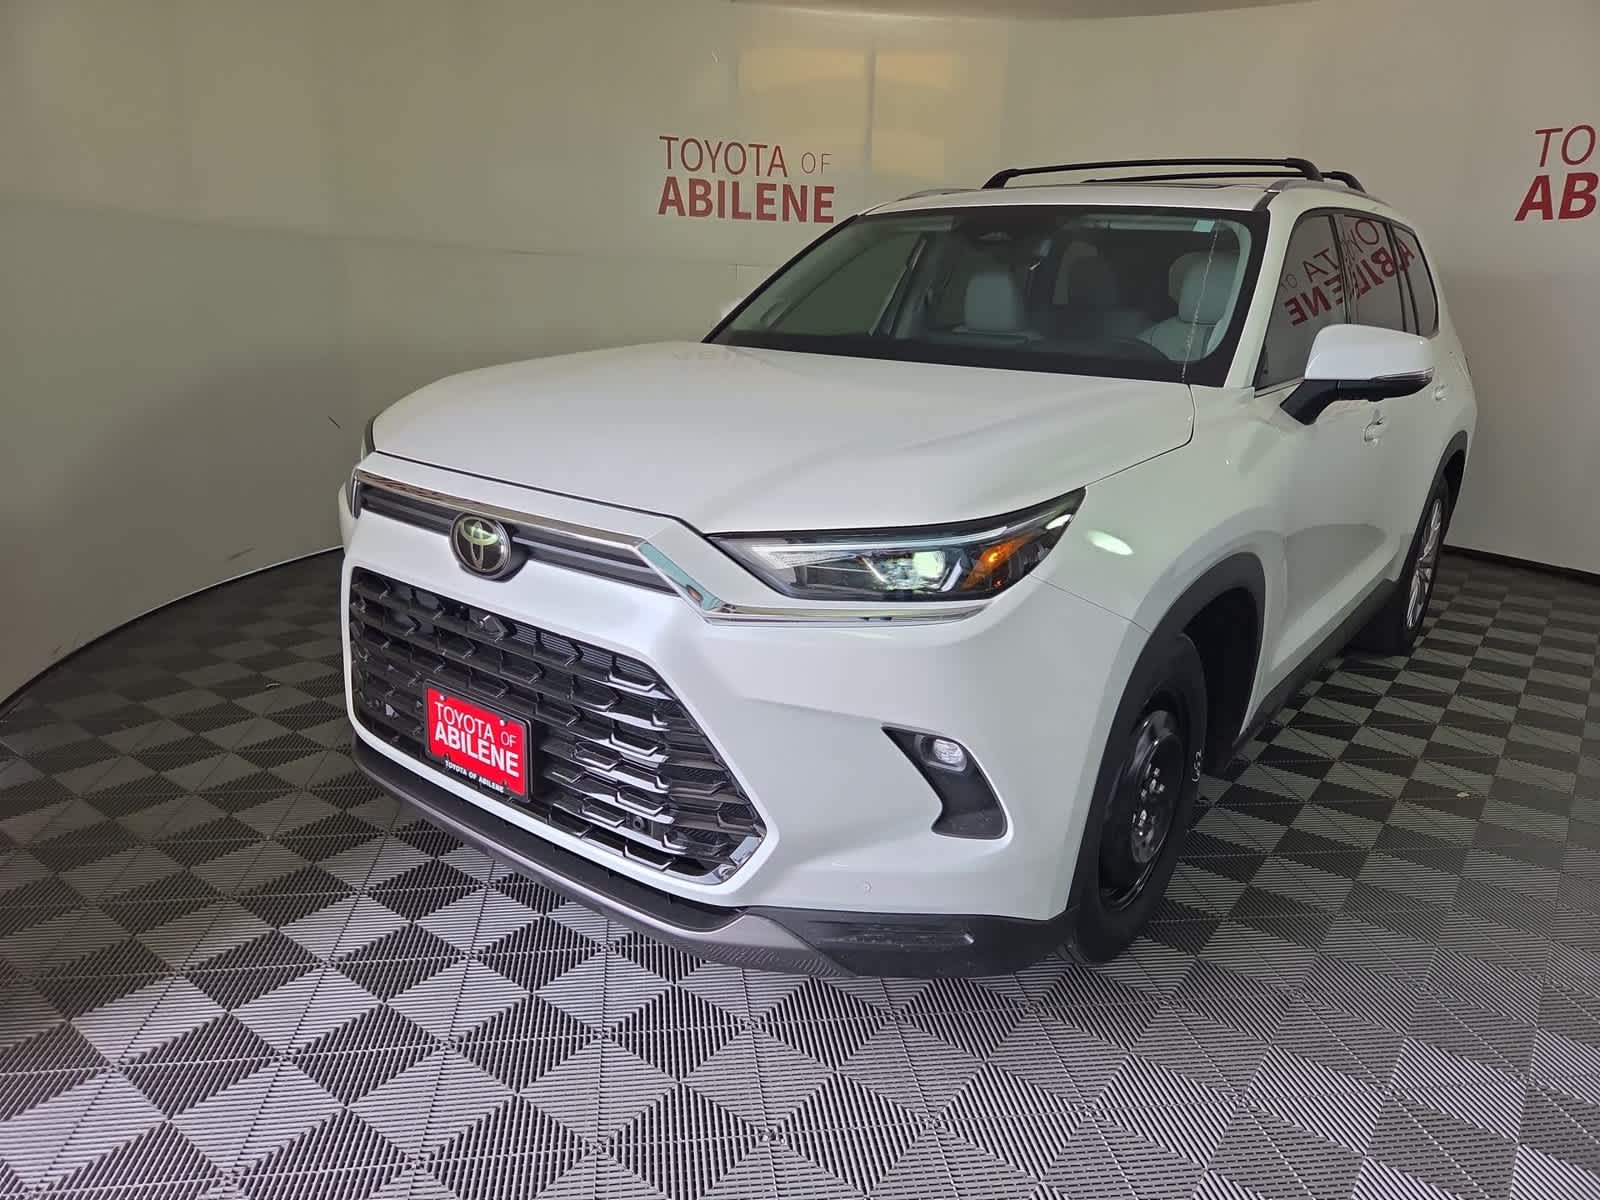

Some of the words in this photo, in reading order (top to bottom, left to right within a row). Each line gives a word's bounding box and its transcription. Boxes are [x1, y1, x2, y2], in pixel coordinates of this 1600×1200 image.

[659, 135, 788, 178] TOYOTA
[801, 152, 833, 175] OF
[1535, 124, 1596, 168] TO
[658, 176, 835, 224] ABILENE
[1514, 171, 1599, 221] AB
[434, 701, 495, 743] TOYOTA
[501, 731, 517, 747] OF
[434, 721, 519, 778] ABILENE
[445, 760, 468, 776] TOYOTA
[468, 772, 478, 780] OF
[478, 776, 505, 794] ABILENE
